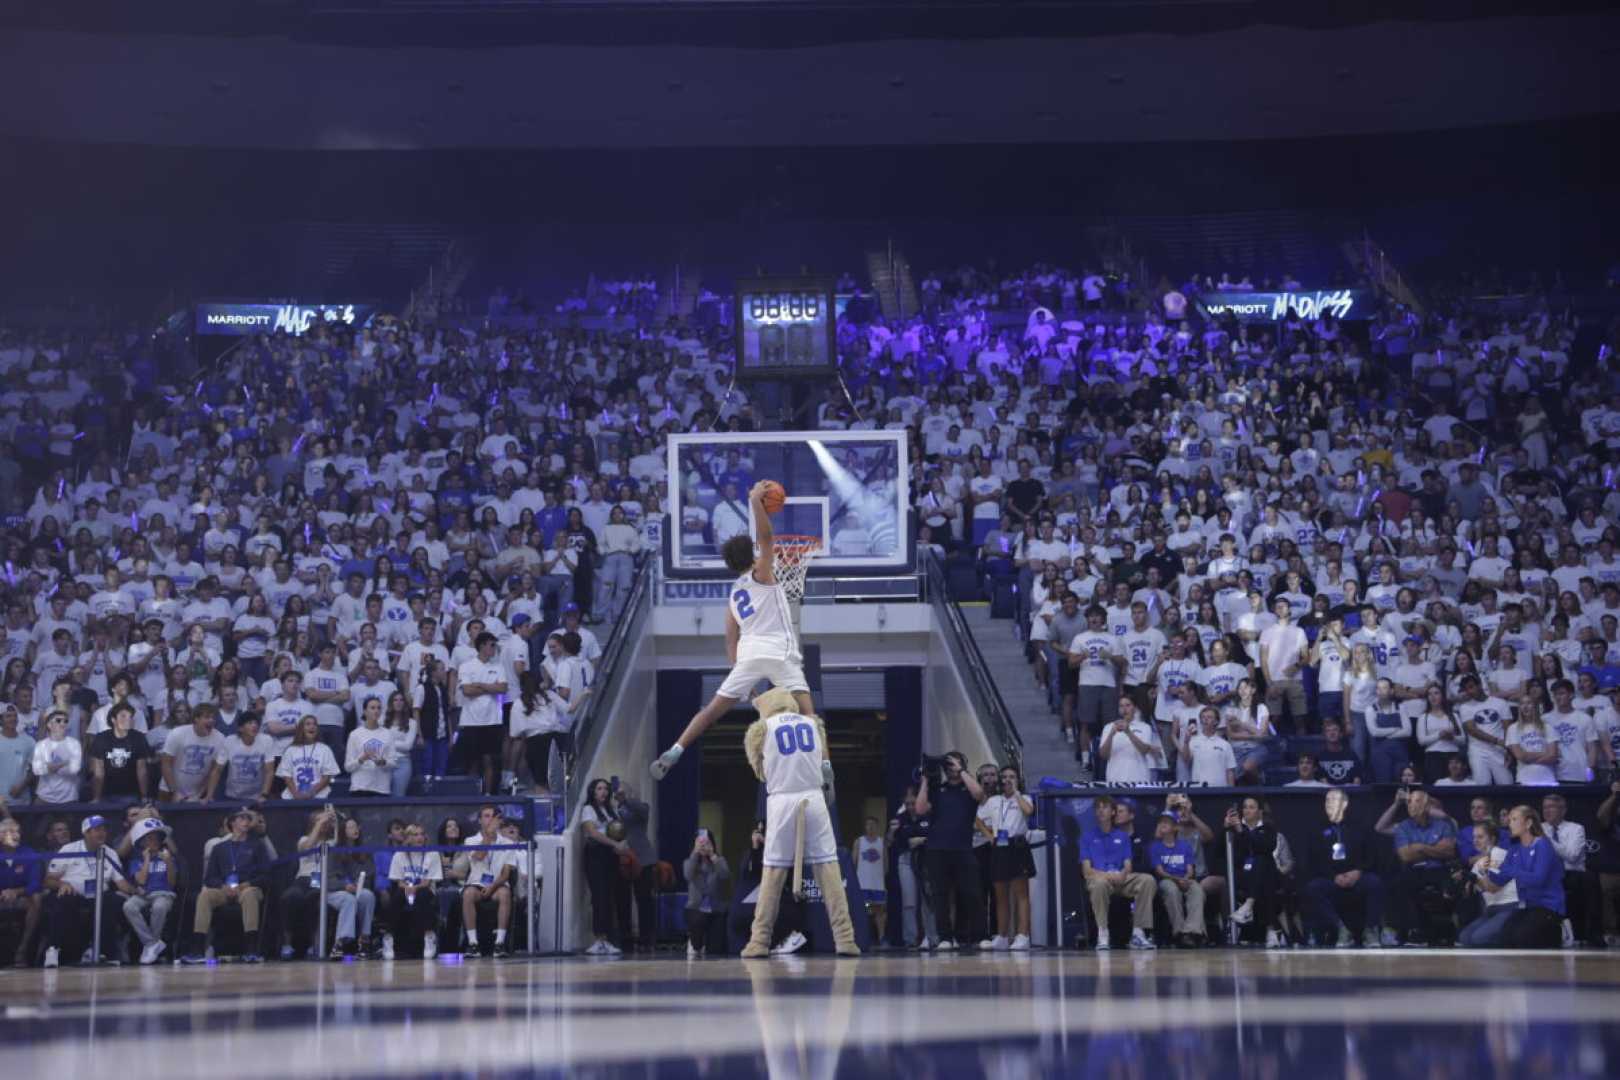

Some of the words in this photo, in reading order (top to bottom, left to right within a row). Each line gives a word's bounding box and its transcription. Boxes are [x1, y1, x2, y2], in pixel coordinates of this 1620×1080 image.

[207, 314, 270, 325] MARRIOTT
[734, 589, 755, 620] 2
[774, 723, 815, 756] 00
